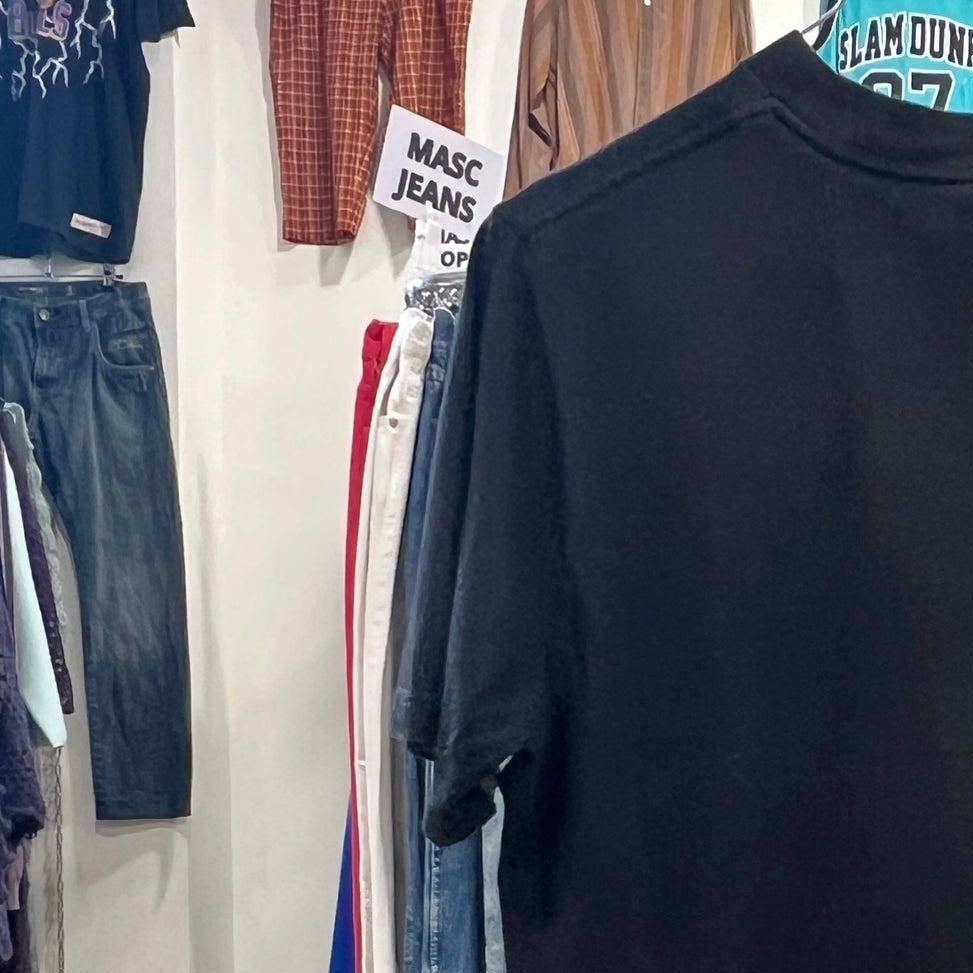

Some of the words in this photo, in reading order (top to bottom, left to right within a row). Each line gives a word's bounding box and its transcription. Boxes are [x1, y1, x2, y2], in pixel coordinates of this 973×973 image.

[838, 12, 905, 72] SLAM
[406, 131, 484, 188] MASC
[391, 168, 478, 224] JEANS
